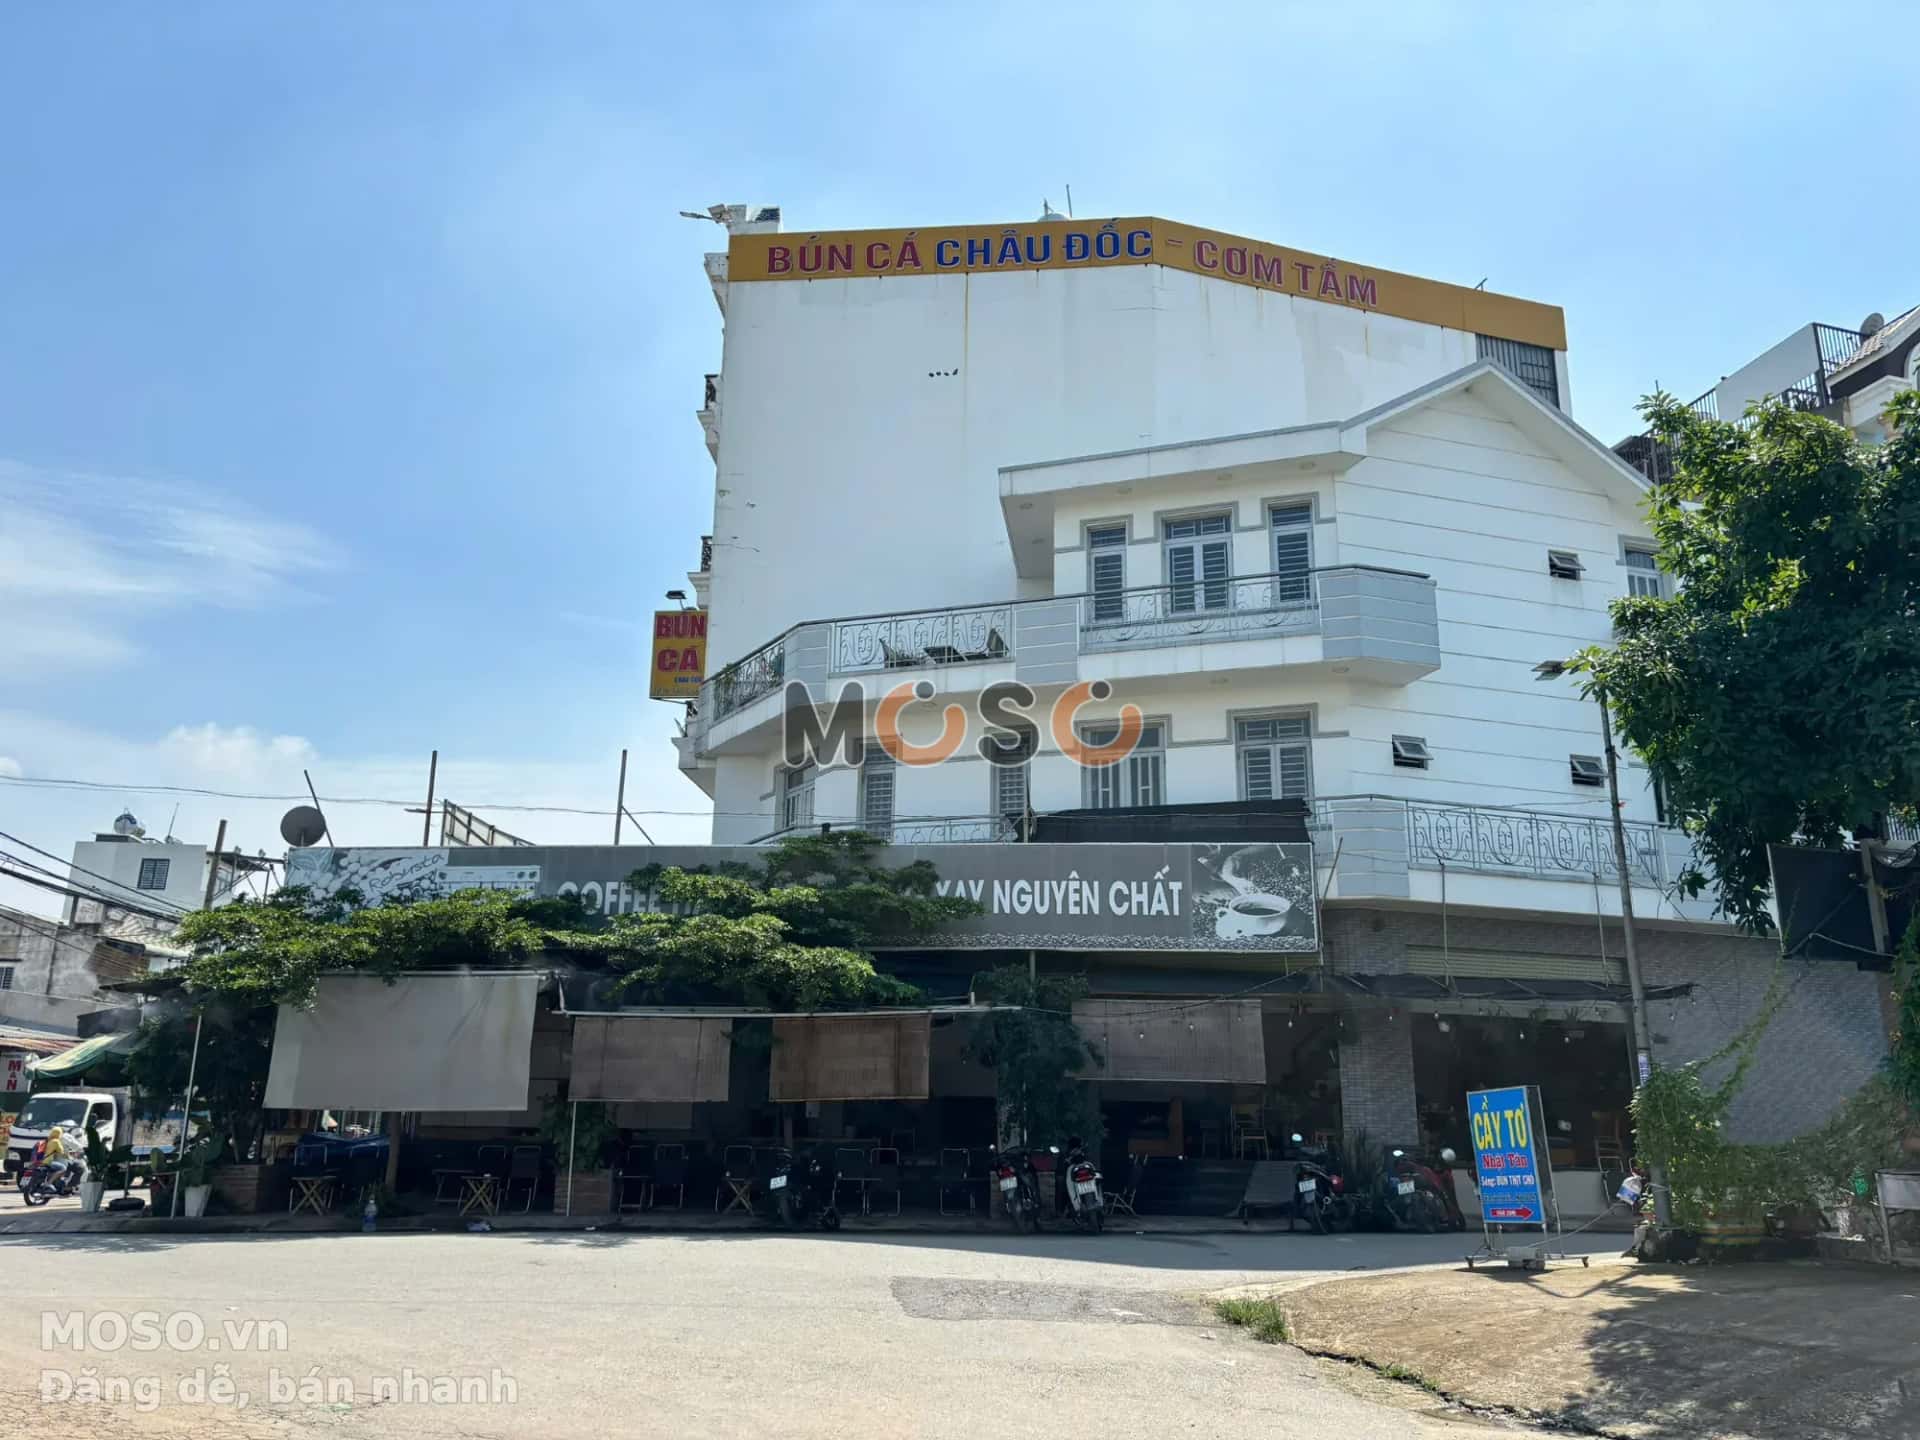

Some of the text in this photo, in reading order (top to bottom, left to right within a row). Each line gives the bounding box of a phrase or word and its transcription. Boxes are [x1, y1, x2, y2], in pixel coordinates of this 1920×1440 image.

[767, 233, 854, 274] BÚN
[865, 231, 923, 271] CÁ
[935, 229, 1051, 268] CHÂU
[1062, 217, 1152, 262] ĐỐC
[1194, 239, 1283, 287] CƠM
[992, 870, 1100, 916] NGUYÊN
[1108, 864, 1183, 917] CHẤT
